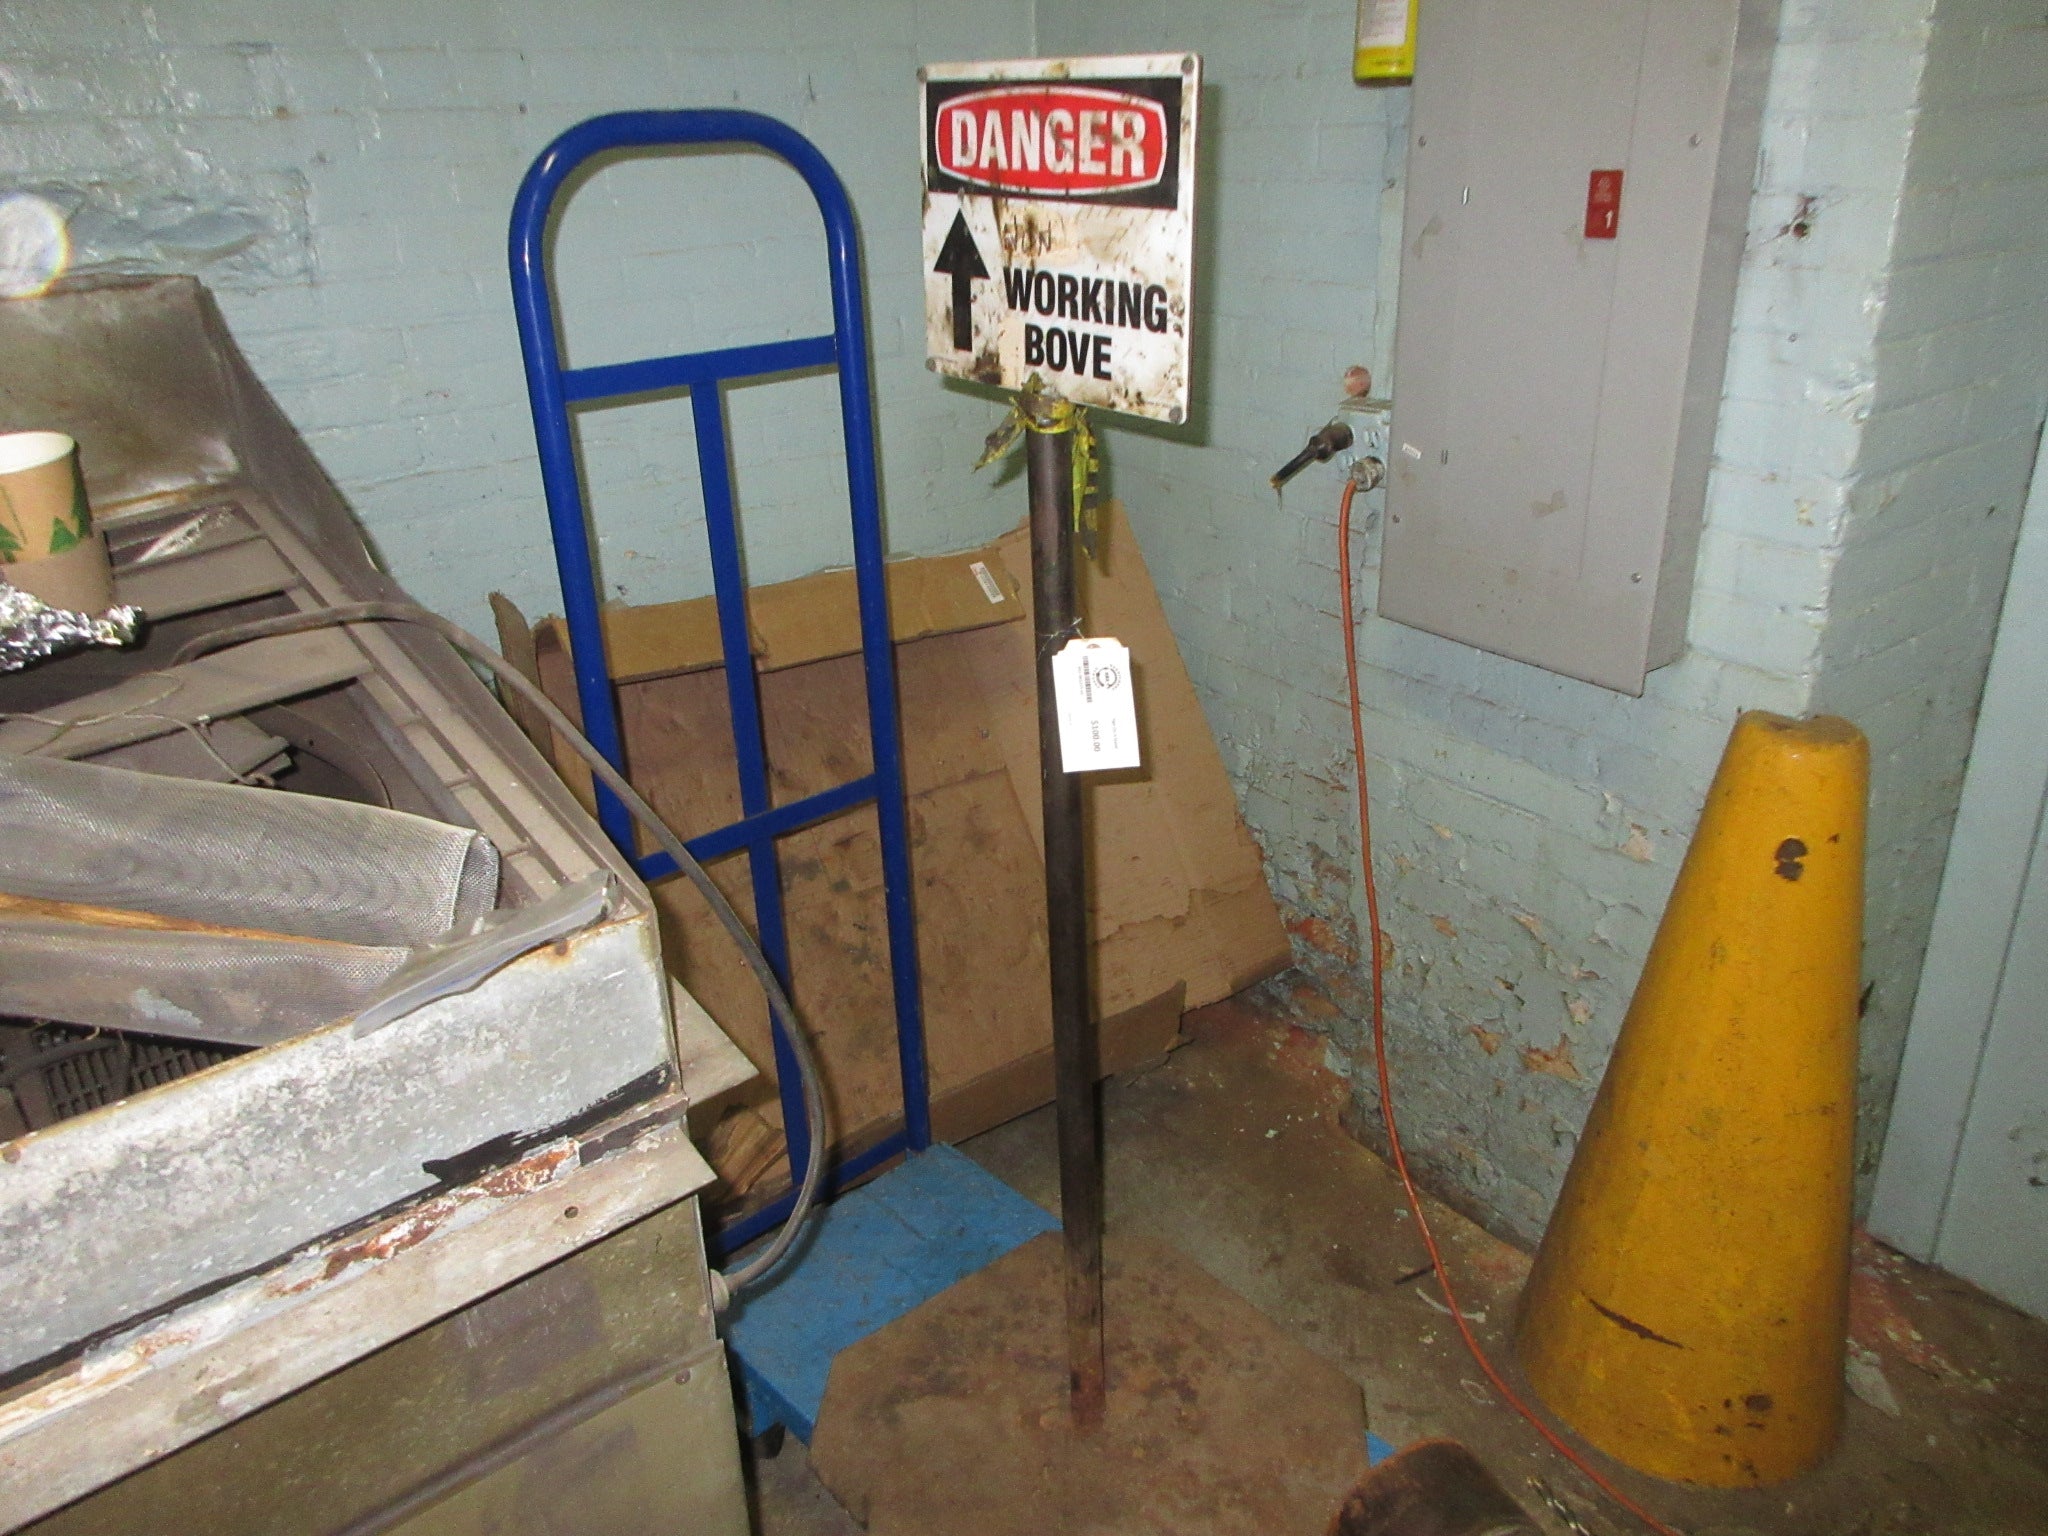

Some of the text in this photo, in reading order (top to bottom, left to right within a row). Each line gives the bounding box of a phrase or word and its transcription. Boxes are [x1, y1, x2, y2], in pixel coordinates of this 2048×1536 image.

[951, 108, 1146, 177] DANGER
[1003, 266, 1168, 334] WORKING
[1025, 323, 1112, 381] BOVE
[1091, 720, 1101, 752] $100.00
